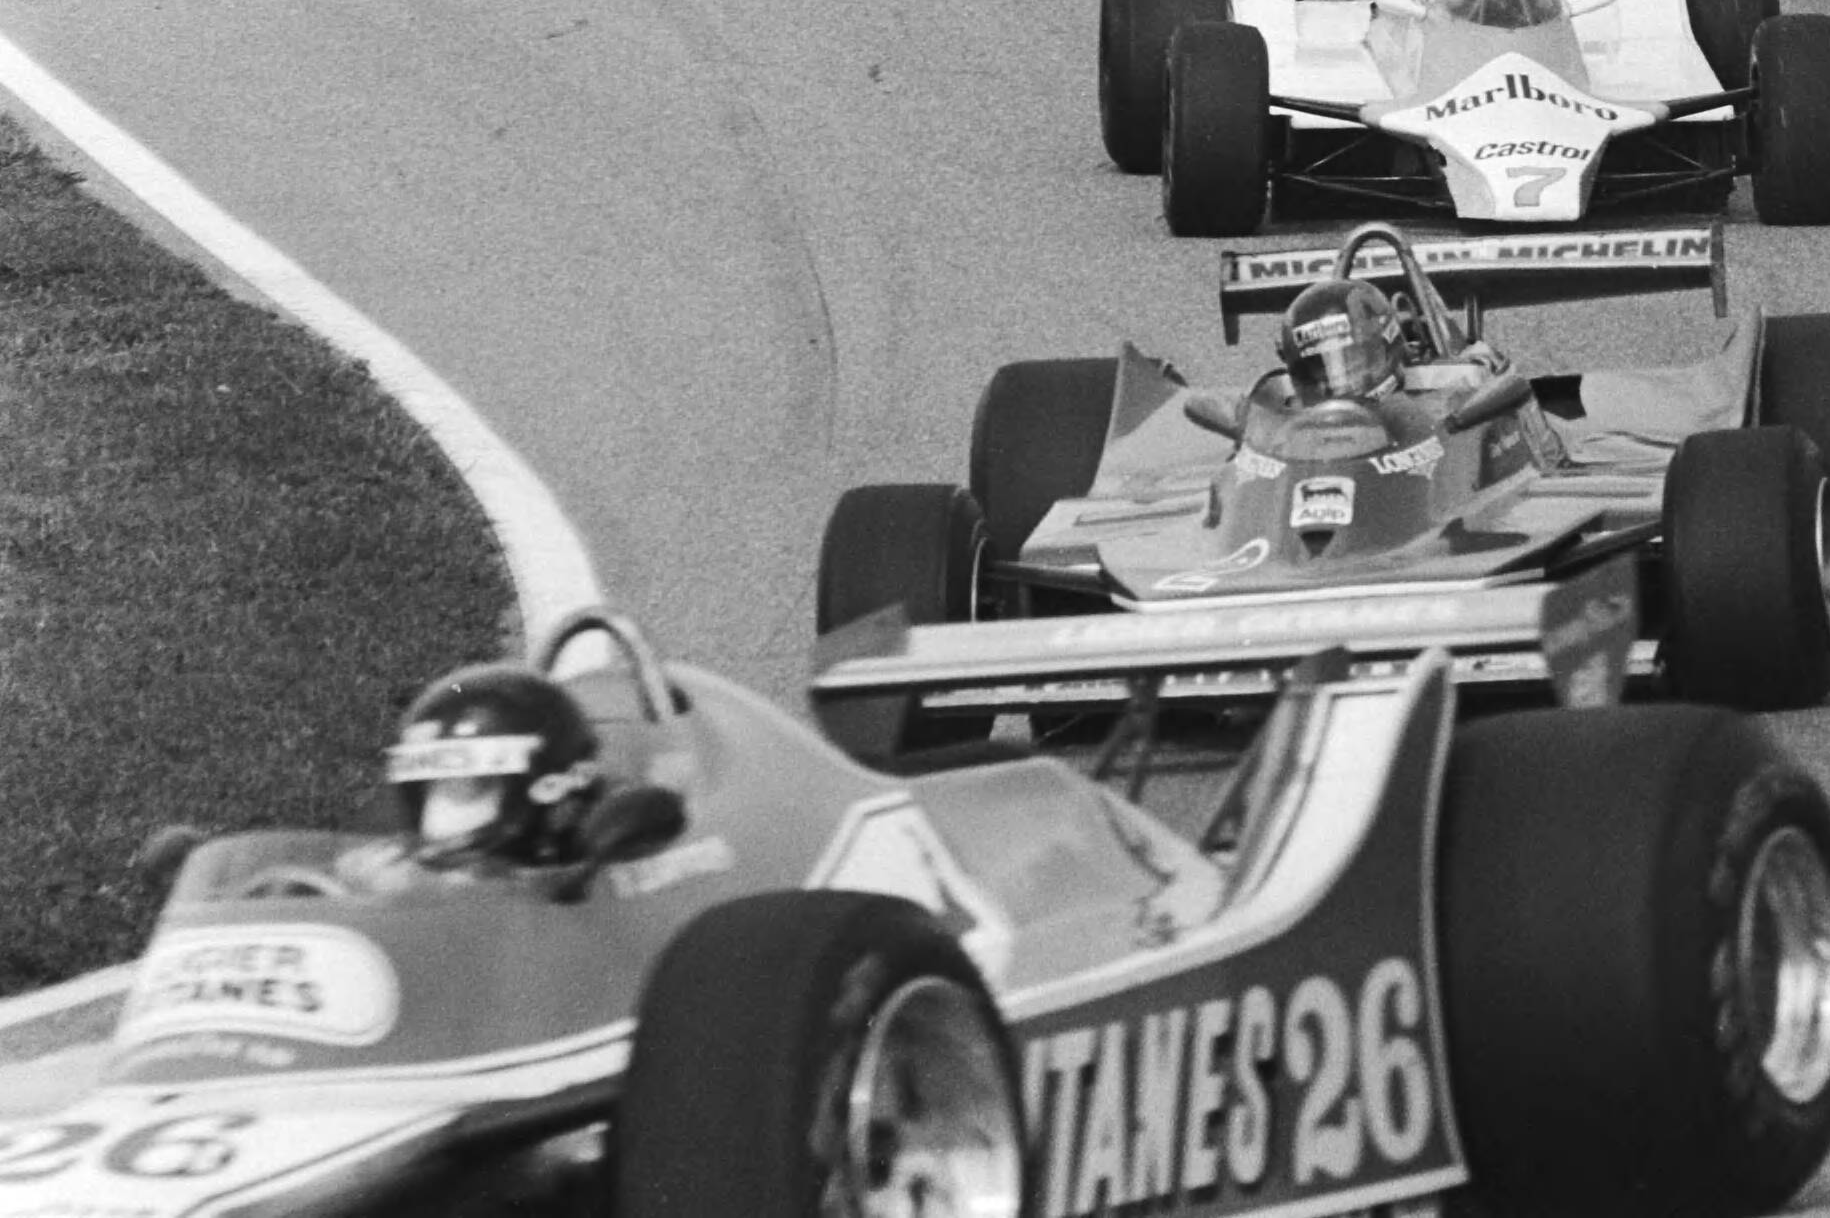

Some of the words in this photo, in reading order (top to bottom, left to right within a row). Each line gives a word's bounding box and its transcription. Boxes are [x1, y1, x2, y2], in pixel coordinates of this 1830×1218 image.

[1426, 73, 1619, 121] Marlboro
[1474, 140, 1591, 161] Castrol
[1505, 166, 1567, 208] 7
[1021, 985, 1277, 1218] ITANES
[1283, 957, 1433, 1184] 26
